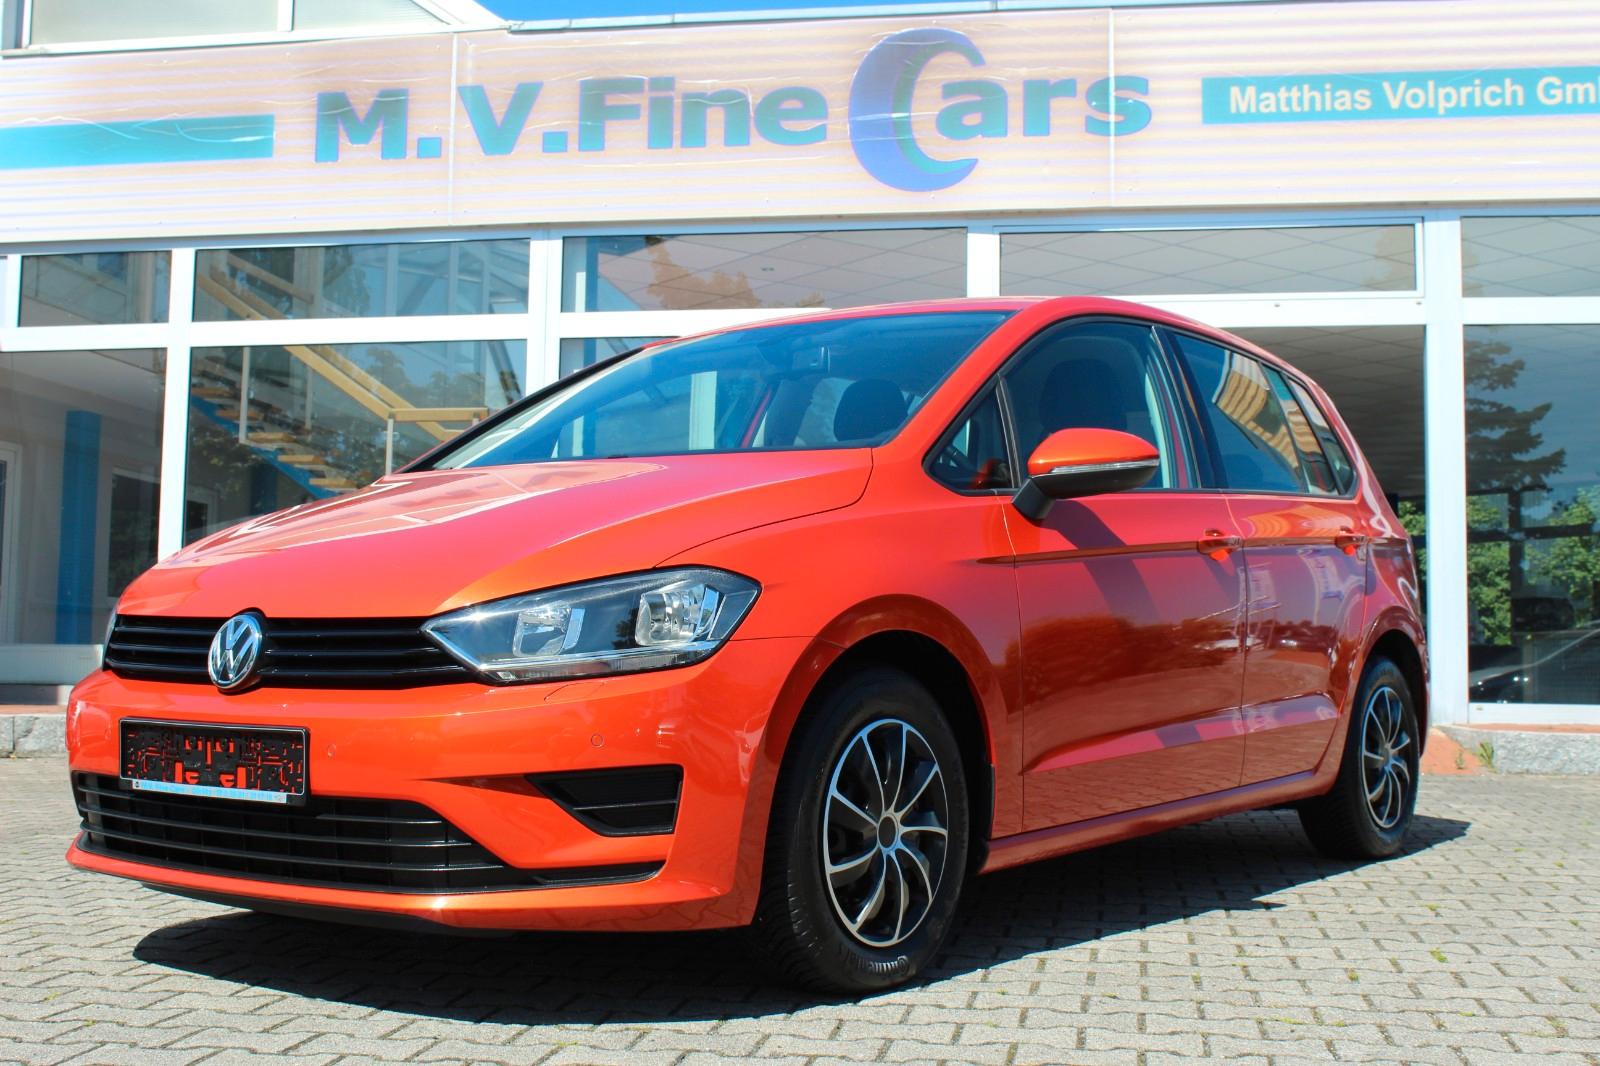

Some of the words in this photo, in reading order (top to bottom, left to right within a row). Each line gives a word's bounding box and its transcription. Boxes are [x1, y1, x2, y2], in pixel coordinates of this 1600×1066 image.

[1229, 83, 1373, 114] Matthias
[1382, 77, 1525, 115] Volprich
[1535, 75, 1600, 107] Gm
